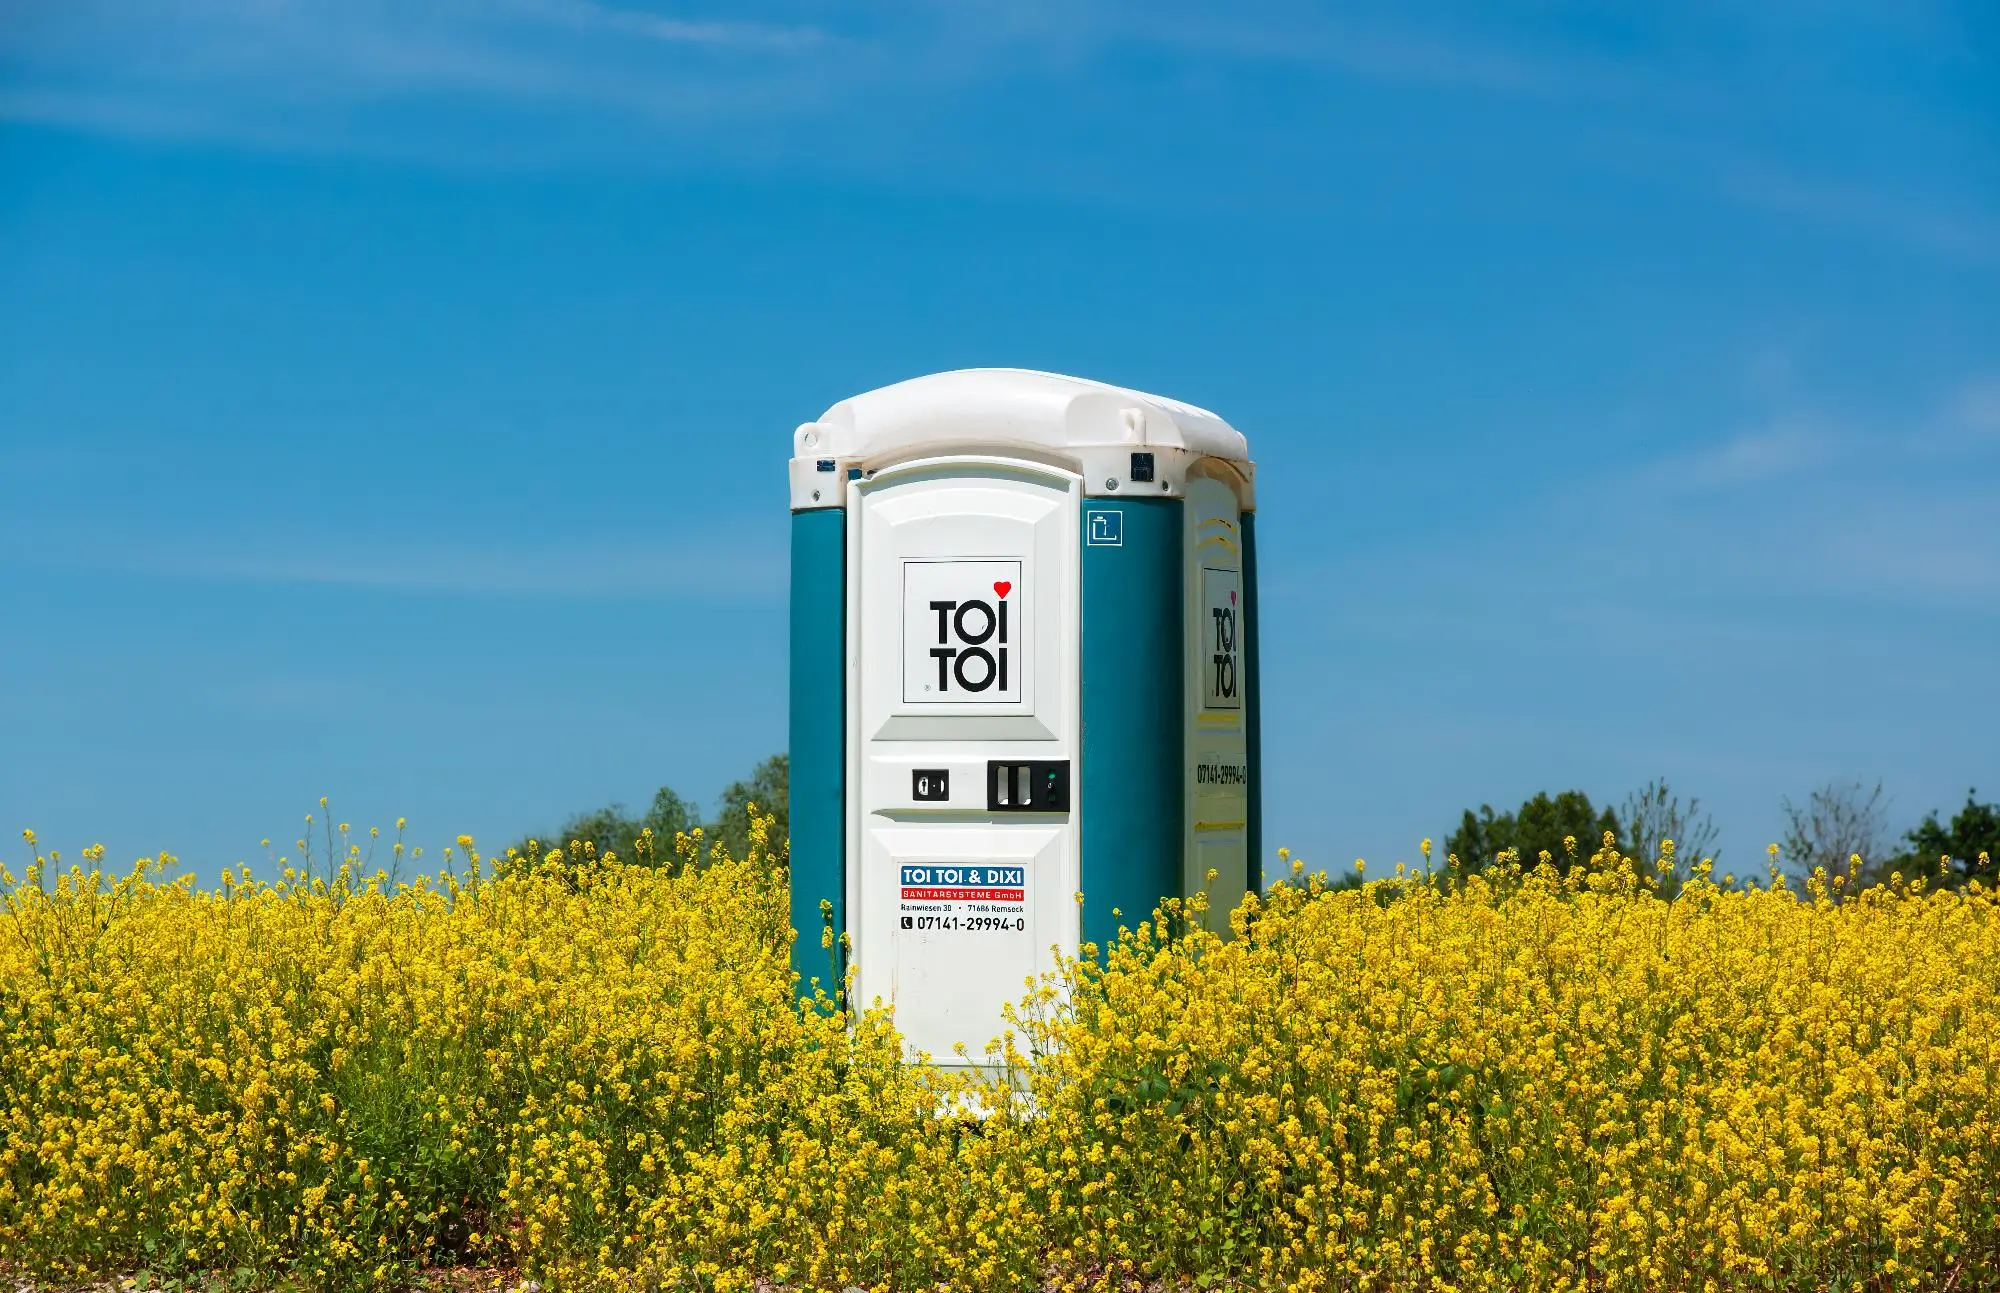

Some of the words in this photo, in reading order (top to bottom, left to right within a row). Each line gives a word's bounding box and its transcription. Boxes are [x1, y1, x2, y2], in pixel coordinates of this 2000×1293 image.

[929, 599, 1008, 645] TOI
[1213, 608, 1237, 652] TOI
[929, 646, 1008, 692] TOI
[1214, 653, 1237, 698] TOI
[903, 869, 931, 884] TOI
[936, 869, 963, 884] TOI
[968, 869, 982, 884] &
[987, 870, 1022, 884] DIXI
[943, 904, 952, 912] 30
[991, 905, 1024, 913] Remseck
[994, 891, 1022, 899] GmbH
[917, 916, 1025, 931] 07141-29994-0
